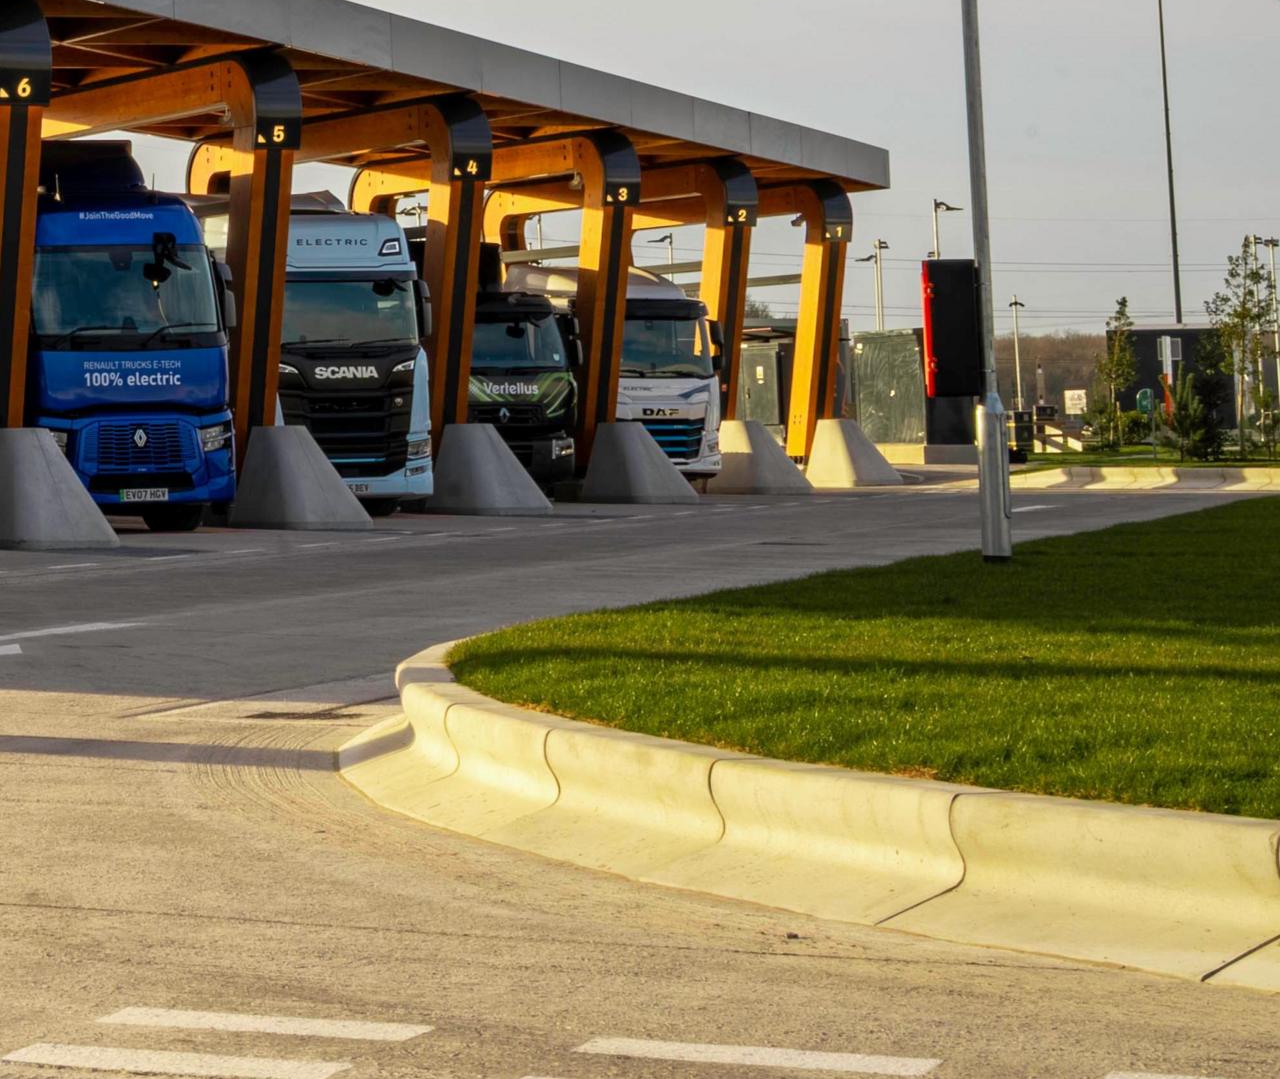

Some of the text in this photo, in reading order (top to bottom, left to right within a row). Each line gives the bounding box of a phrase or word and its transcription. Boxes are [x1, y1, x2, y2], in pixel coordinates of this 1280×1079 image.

[17, 77, 31, 98] 6
[272, 125, 285, 142] 5
[467, 159, 477, 175] 4
[618, 187, 628, 201] 3
[738, 209, 746, 222] 2
[836, 226, 842, 238] 1
[296, 238, 368, 246] ELECTRIC
[84, 360, 181, 370] RENAULT TRUCKS E-TECH
[84, 371, 181, 387] 100% electric
[315, 366, 378, 379] SCANIA
[483, 382, 539, 395] Vertellus
[642, 408, 680, 417] DAF
